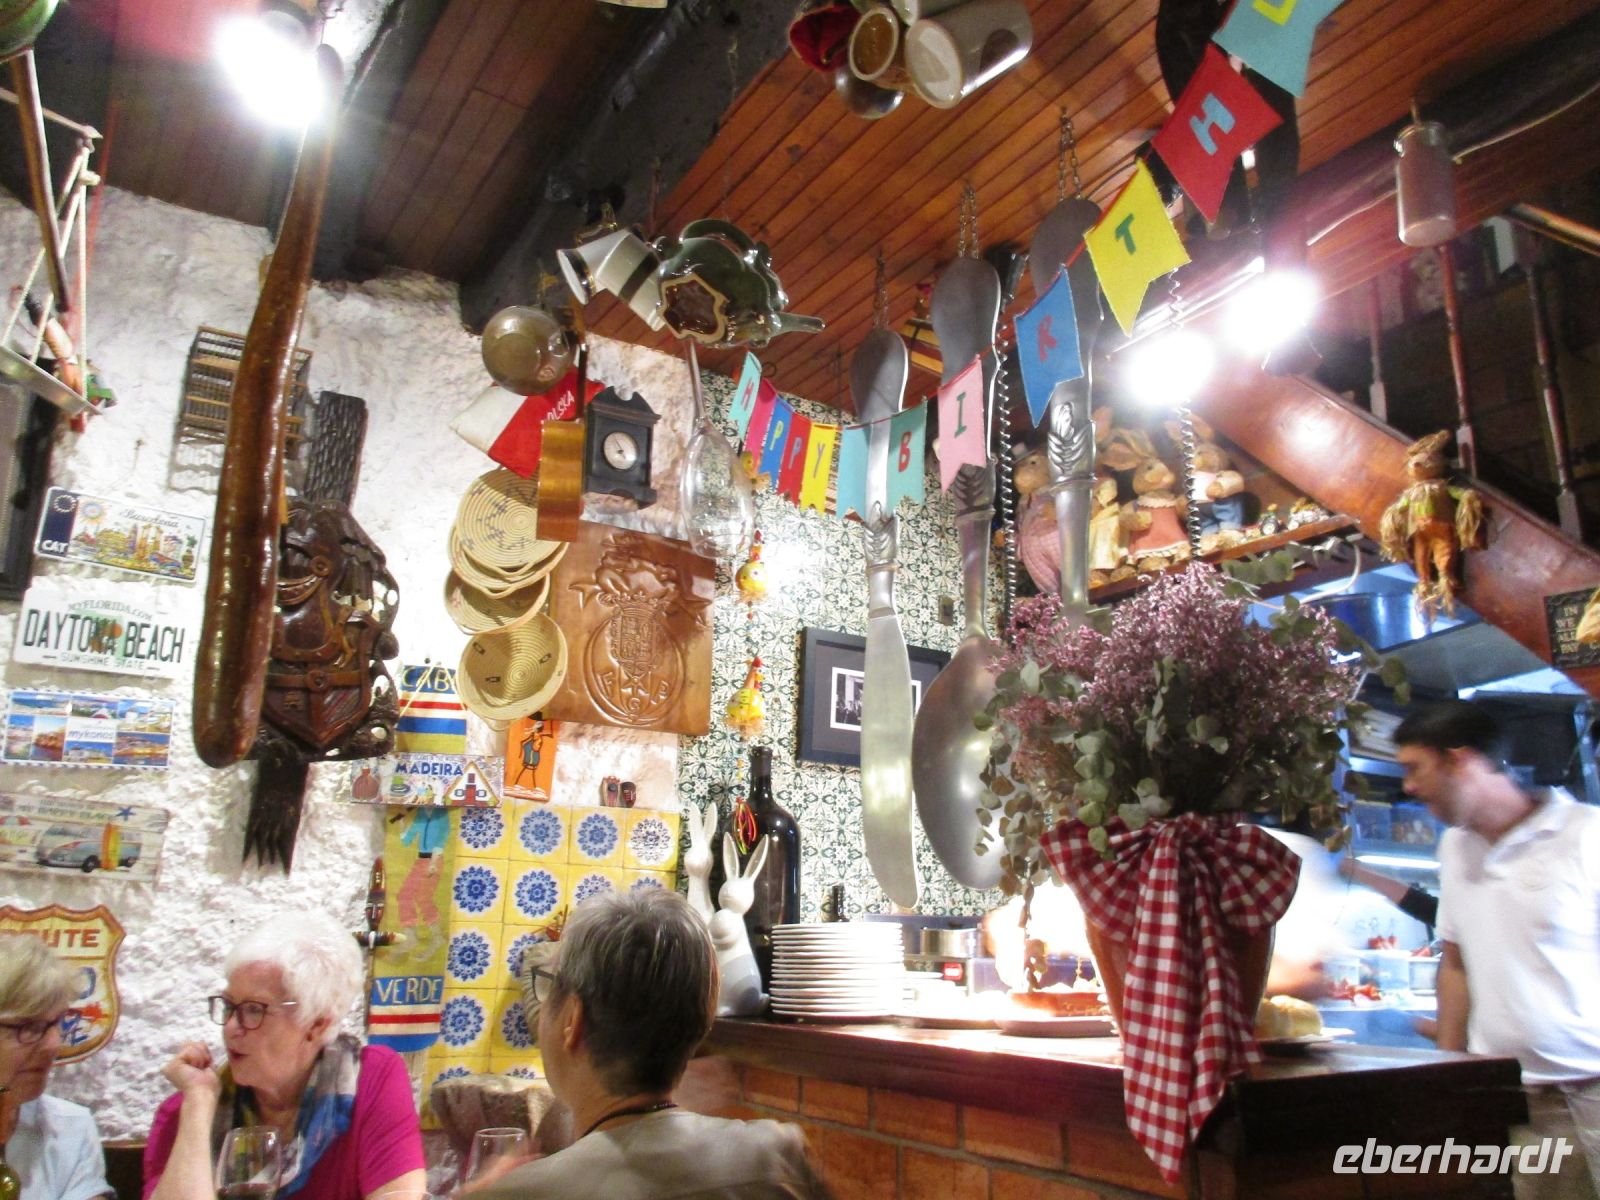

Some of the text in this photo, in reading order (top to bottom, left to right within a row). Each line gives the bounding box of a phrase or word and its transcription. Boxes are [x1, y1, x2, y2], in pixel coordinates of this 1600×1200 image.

[546, 390, 575, 420] OLSKA
[41, 539, 69, 553] CAT
[23, 609, 185, 664] DAYTONA BEACH
[400, 666, 457, 692] CAB
[395, 762, 464, 776] MADEIRA
[374, 976, 443, 1004] VERDE
